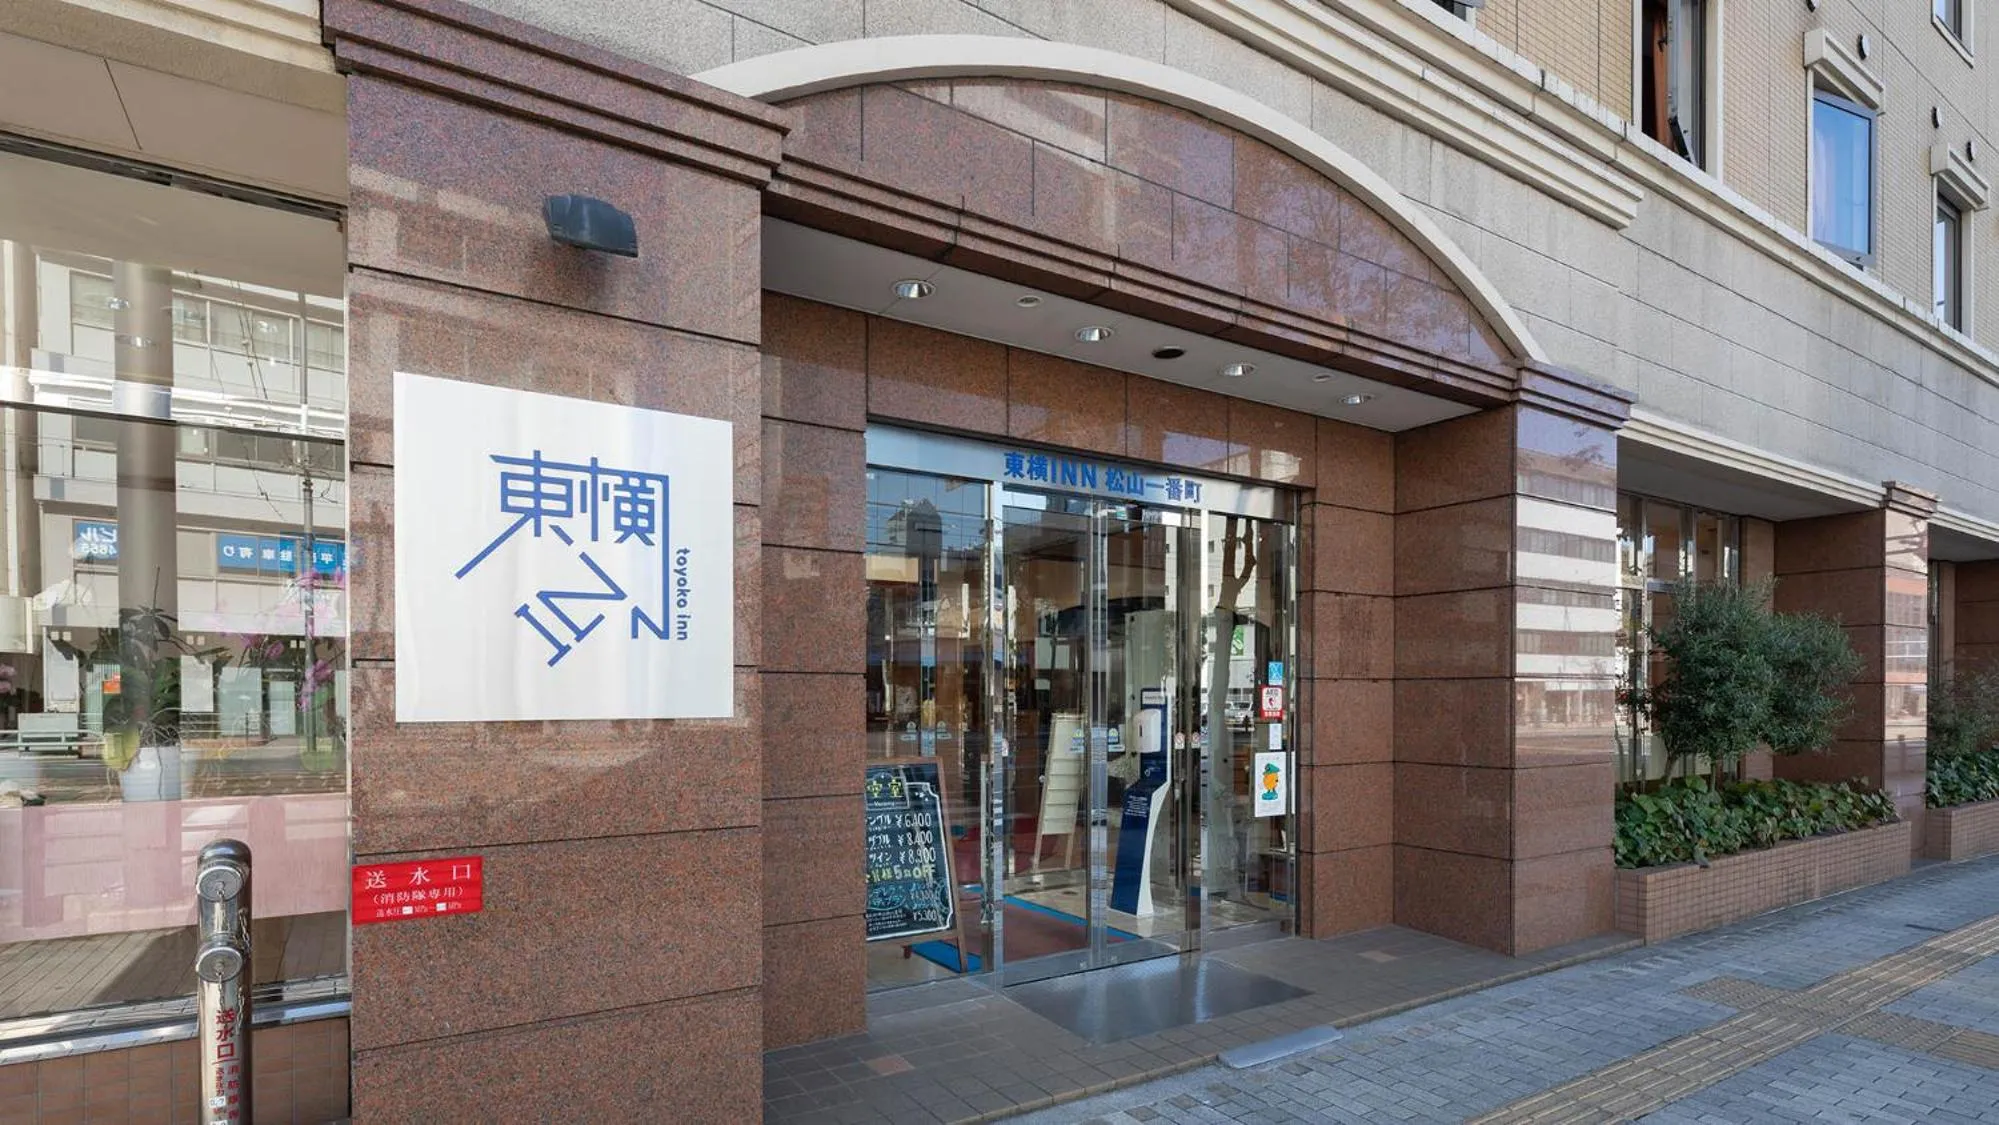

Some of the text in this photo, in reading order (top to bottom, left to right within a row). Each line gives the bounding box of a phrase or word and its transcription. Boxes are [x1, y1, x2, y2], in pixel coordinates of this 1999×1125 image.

[1003, 452, 1202, 503] 東横INN 松山一番町
[674, 547, 691, 641] toyoko inn
[866, 814, 892, 826] ングル
[364, 863, 471, 890] 送水口
[215, 1009, 235, 1058] 送水口
